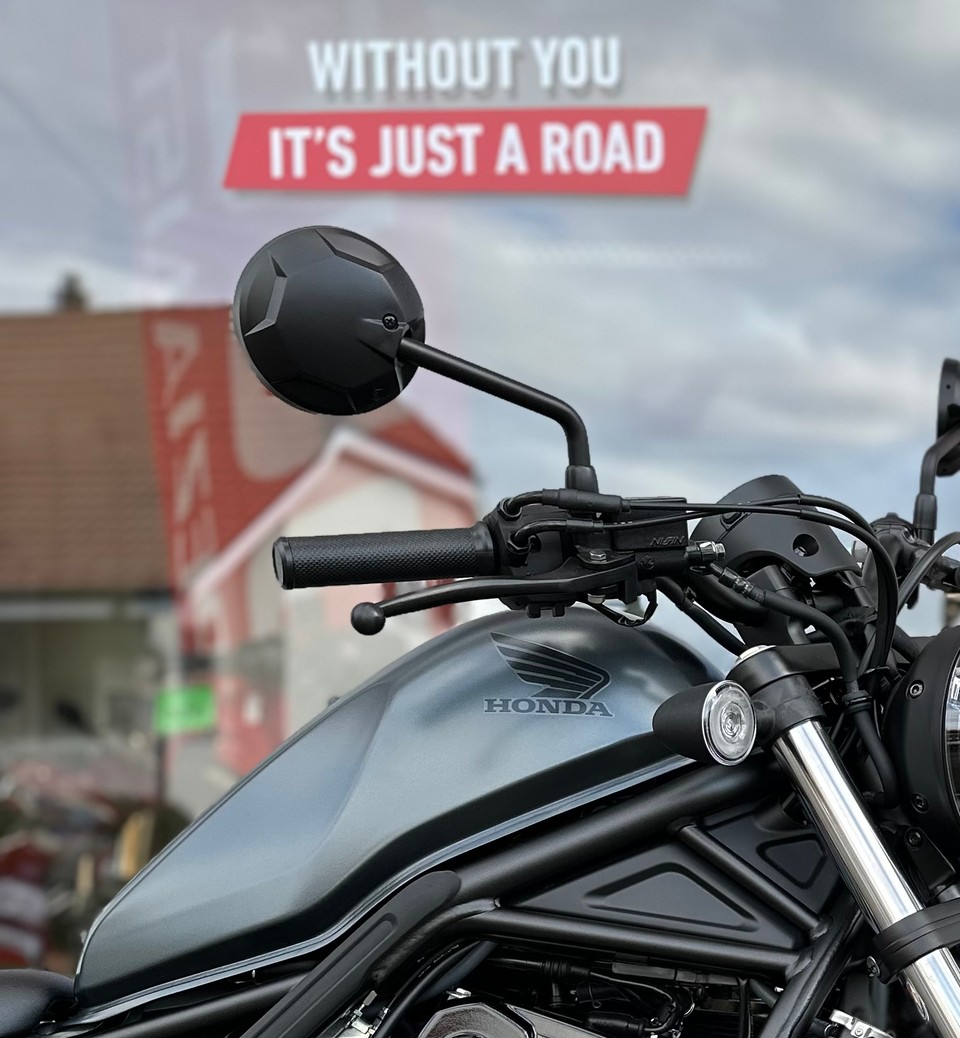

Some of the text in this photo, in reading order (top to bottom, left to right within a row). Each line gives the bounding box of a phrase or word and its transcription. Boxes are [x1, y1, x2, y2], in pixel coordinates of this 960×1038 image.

[309, 36, 621, 92] WITHOUT YOU
[368, 123, 484, 178] JUST
[494, 121, 529, 175] A
[540, 120, 665, 174] ROAD
[483, 698, 614, 717] HONDA
